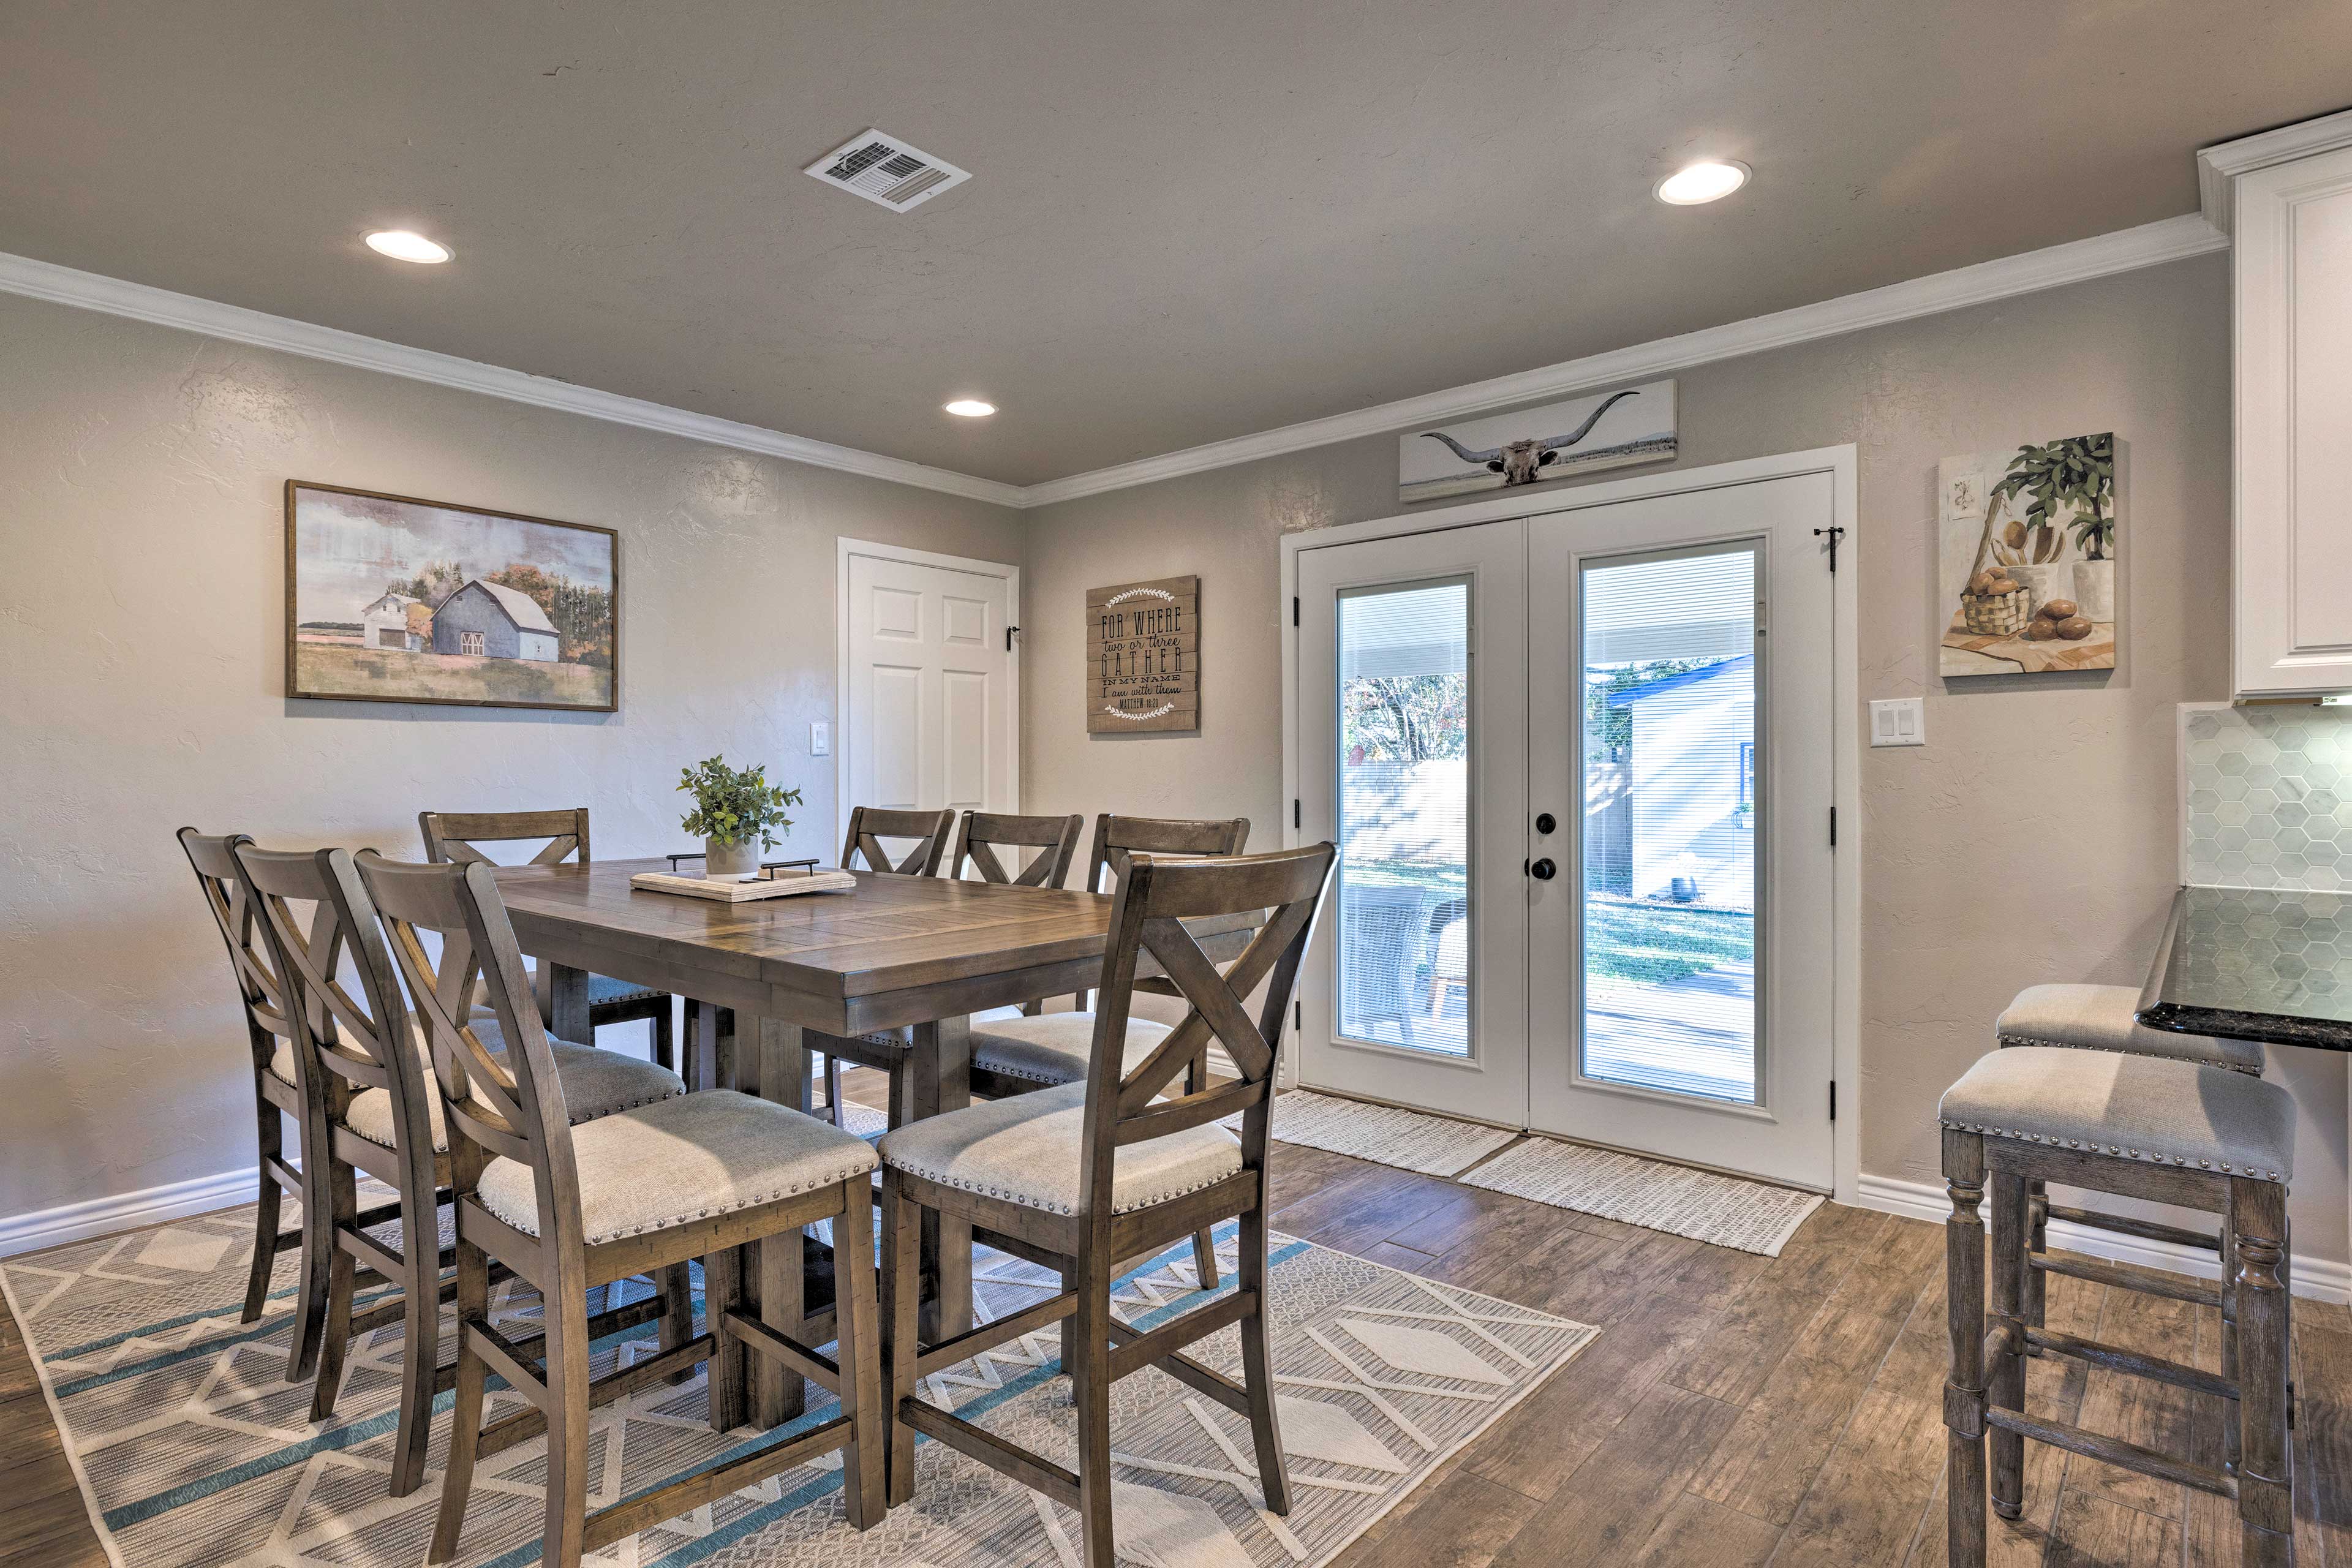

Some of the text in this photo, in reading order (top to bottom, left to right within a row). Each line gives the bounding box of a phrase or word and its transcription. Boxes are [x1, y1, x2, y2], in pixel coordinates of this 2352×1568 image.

[1101, 607, 1181, 639] FOR WHERE
[1102, 634, 1181, 652] two or three
[1102, 647, 1182, 677] GATHER
[1140, 675, 1180, 684] NAME
[1102, 688, 1108, 698] I
[1131, 684, 1153, 695] with
[1155, 684, 1181, 694] them
[1120, 698, 1158, 709] MATTHEW 18:20
